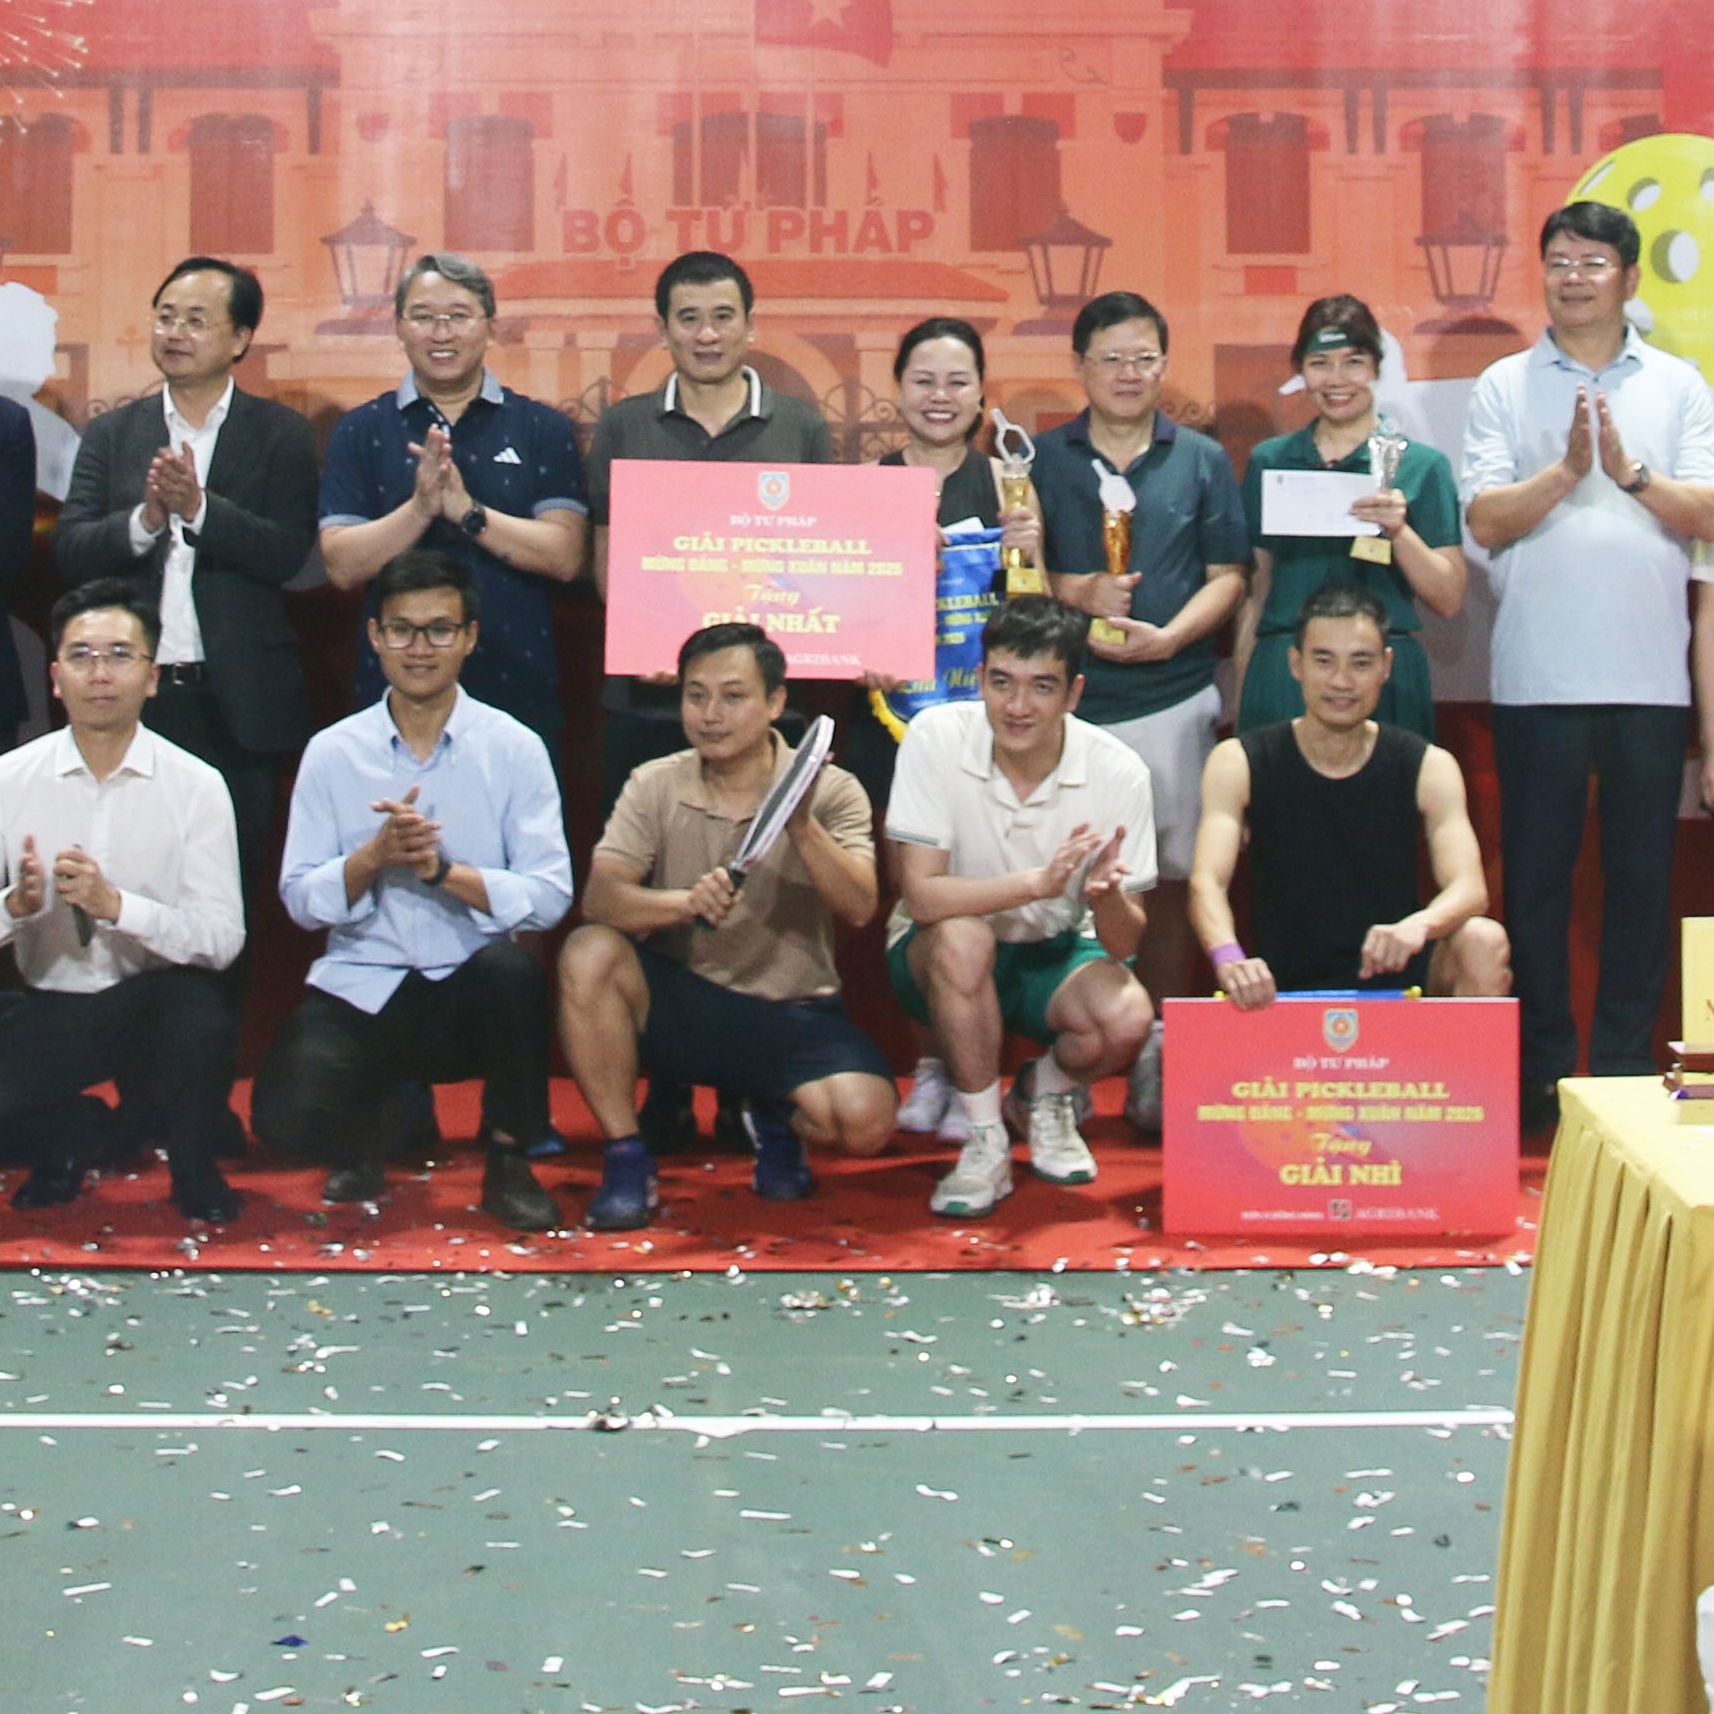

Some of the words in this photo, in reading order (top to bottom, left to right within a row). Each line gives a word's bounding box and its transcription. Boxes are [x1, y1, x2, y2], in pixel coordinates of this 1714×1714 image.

[560, 197, 647, 269] BỘ
[765, 196, 937, 254] PHÁP
[672, 531, 727, 553] GIẢI
[731, 536, 873, 556] PICKLEBALL
[766, 606, 841, 634] NHẤT
[1231, 1076, 1288, 1099] GIẢI
[1294, 1081, 1451, 1100] PICKLEBALL
[1279, 1156, 1342, 1186] GIẢI
